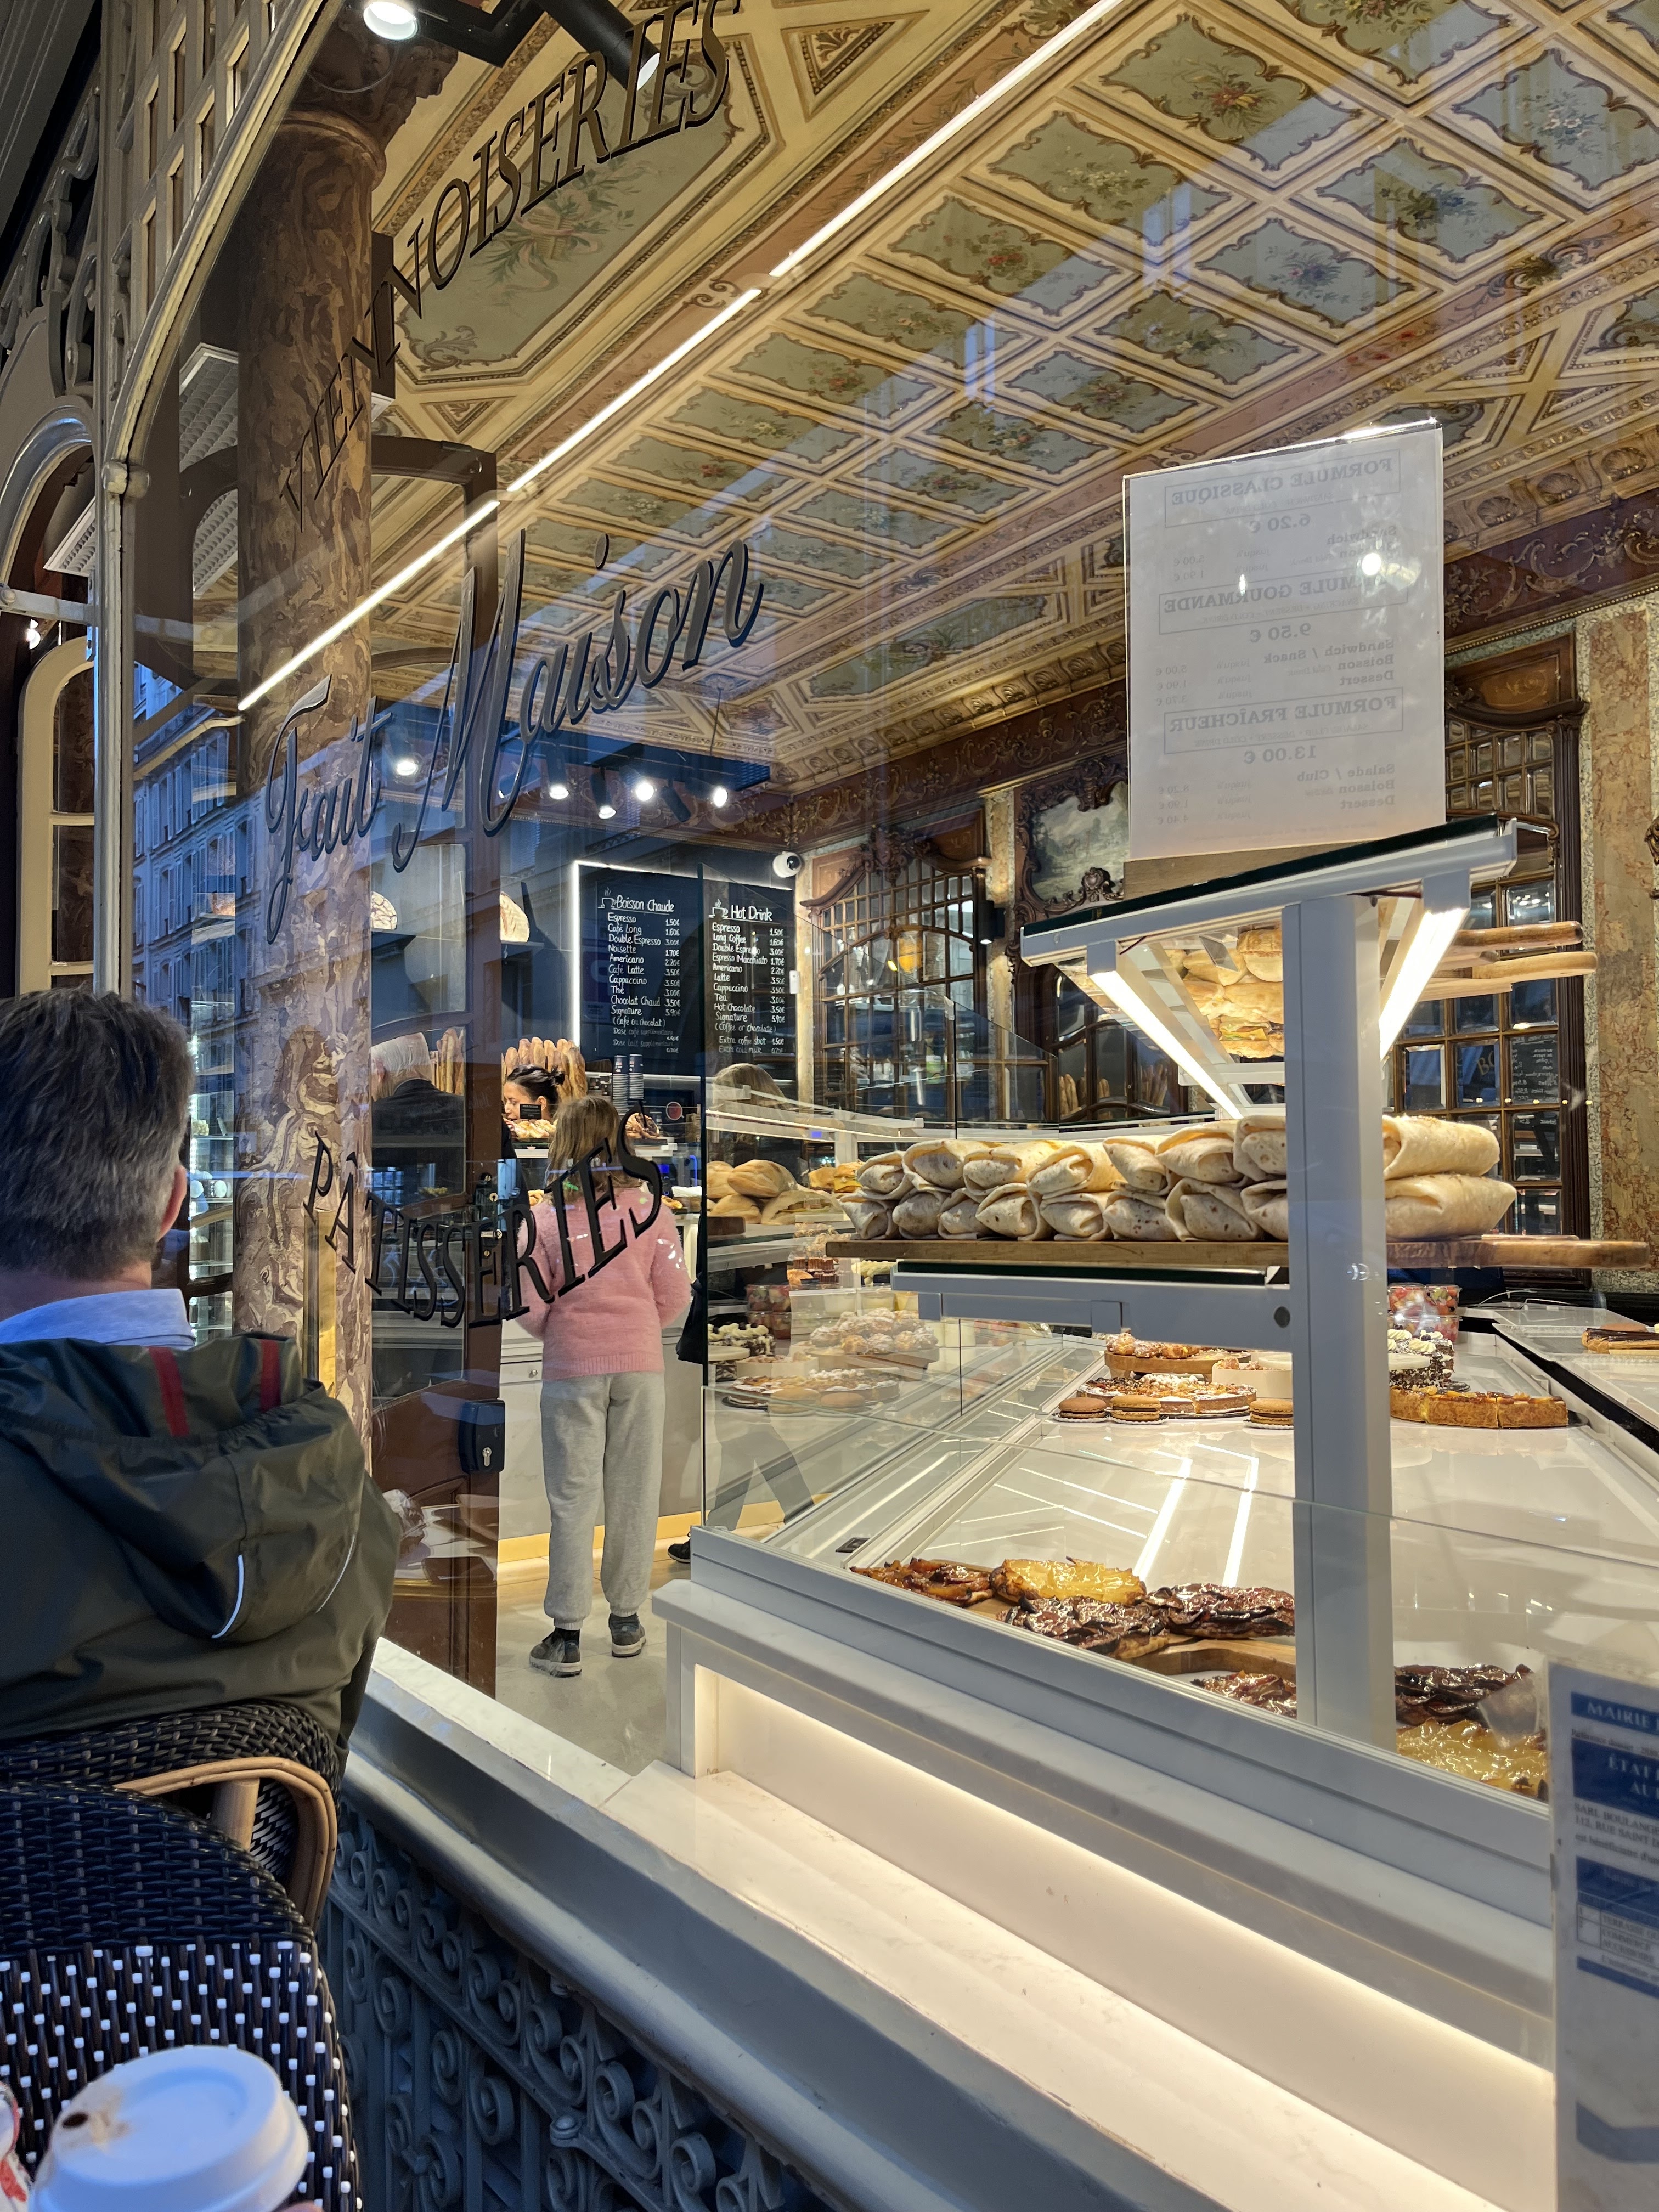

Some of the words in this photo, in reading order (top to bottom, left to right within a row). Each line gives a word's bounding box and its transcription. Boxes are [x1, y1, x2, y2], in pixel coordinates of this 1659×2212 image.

[279, 0, 739, 533] VIENNOISERIES
[265, 675, 395, 944] Fait
[392, 530, 764, 873] Maison
[617, 895, 644, 910] Boisson
[647, 899, 674, 912] Chaude
[608, 912, 636, 925] Espresso
[731, 905, 746, 919] Hot
[748, 906, 772, 921] Drink
[608, 923, 624, 934] Café
[625, 924, 642, 936] Long
[712, 922, 740, 933] Espresso
[609, 934, 633, 943] Double
[634, 935, 661, 947] Espresso
[713, 933, 727, 944] Long
[729, 934, 746, 944] Coffee
[608, 944, 636, 953] Noisette
[713, 943, 734, 952] Double
[610, 953, 644, 963] Americano
[713, 952, 735, 963] Espresso
[737, 955, 768, 964] Macchiato
[609, 964, 624, 975] Café
[627, 965, 645, 974] Latte
[713, 963, 743, 973] Americano
[609, 974, 647, 988] Cappuccino
[714, 973, 730, 981] Latte
[713, 983, 748, 994] Cappuccino
[611, 995, 638, 1005] Chocolat
[641, 996, 661, 1006] Chaud
[714, 993, 727, 1001] Tea
[611, 1005, 642, 1017] Signature
[727, 1003, 755, 1013] Chocolate
[715, 1011, 748, 1023] Signature
[754, 1036, 766, 1045] shot
[1588, 1701, 1649, 1728] MAIRIE
[1574, 1803, 1599, 1818] SARL
[1595, 1821, 1616, 1835] RUE
